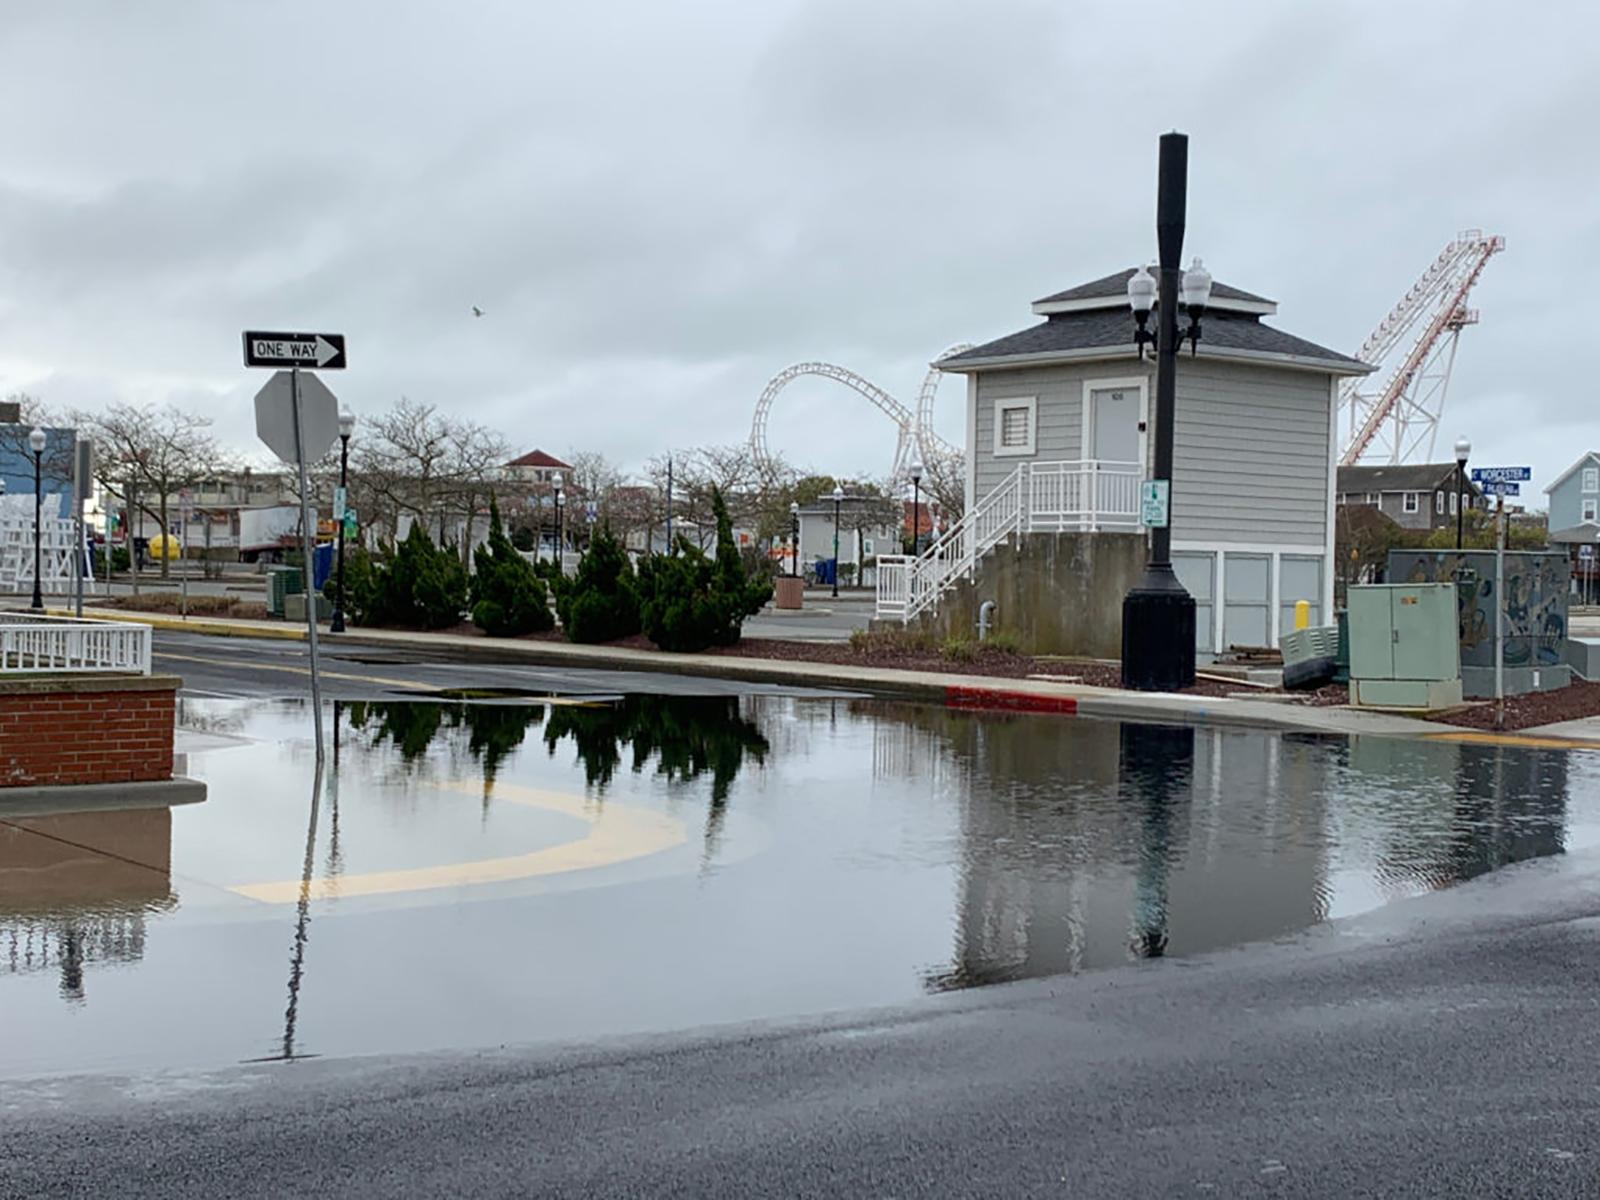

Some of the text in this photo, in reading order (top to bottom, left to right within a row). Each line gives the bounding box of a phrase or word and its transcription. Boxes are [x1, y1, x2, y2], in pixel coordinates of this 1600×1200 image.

[257, 341, 318, 357] ONE WAY
[1481, 467, 1523, 481] WORCESTER
